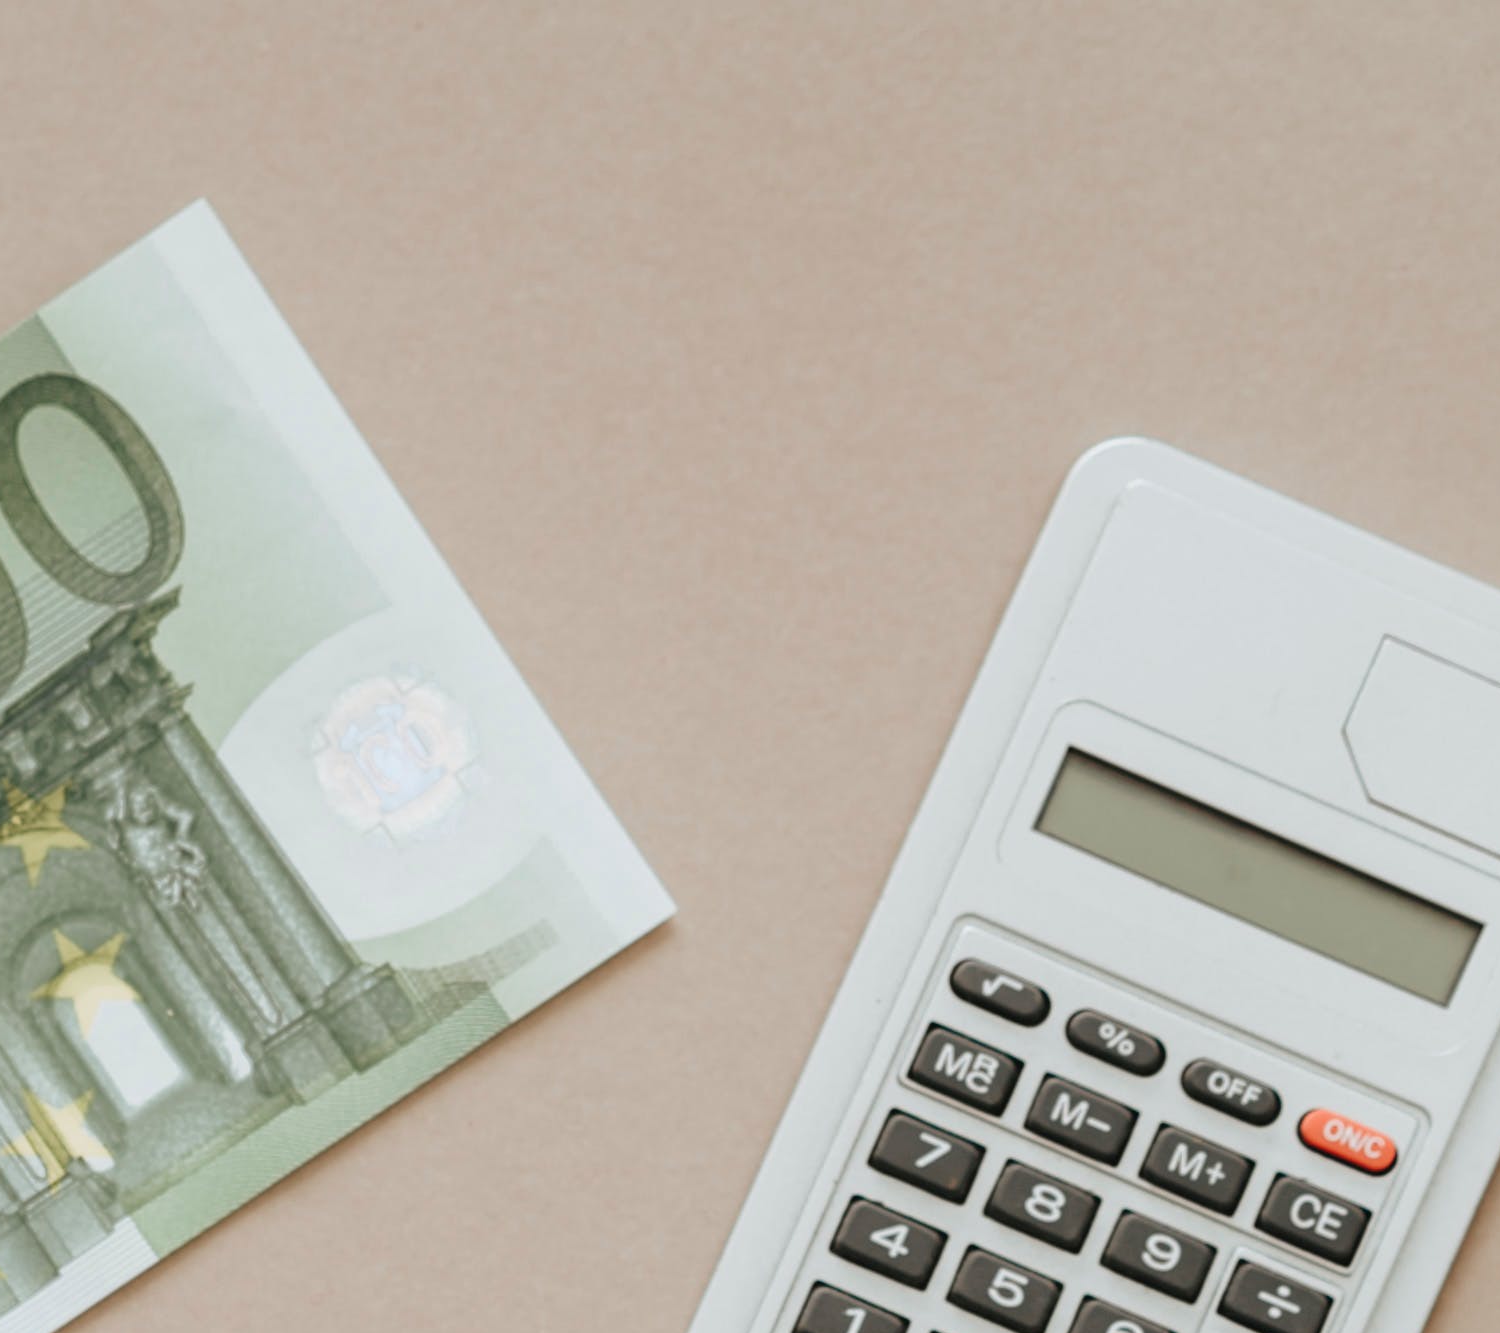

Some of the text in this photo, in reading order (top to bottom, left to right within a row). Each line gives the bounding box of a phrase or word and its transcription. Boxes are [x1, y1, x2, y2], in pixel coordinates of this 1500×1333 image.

[1207, 1070, 1263, 1106] OFF
[915, 1132, 952, 1168] 7
[1322, 1117, 1385, 1160] ON/C
[1168, 1143, 1227, 1185] M+
[1024, 1183, 1066, 1223] 8
[1288, 1194, 1349, 1241] CE
[870, 1224, 909, 1258] 4
[1141, 1233, 1182, 1272] 9
[987, 1273, 1026, 1309] 5
